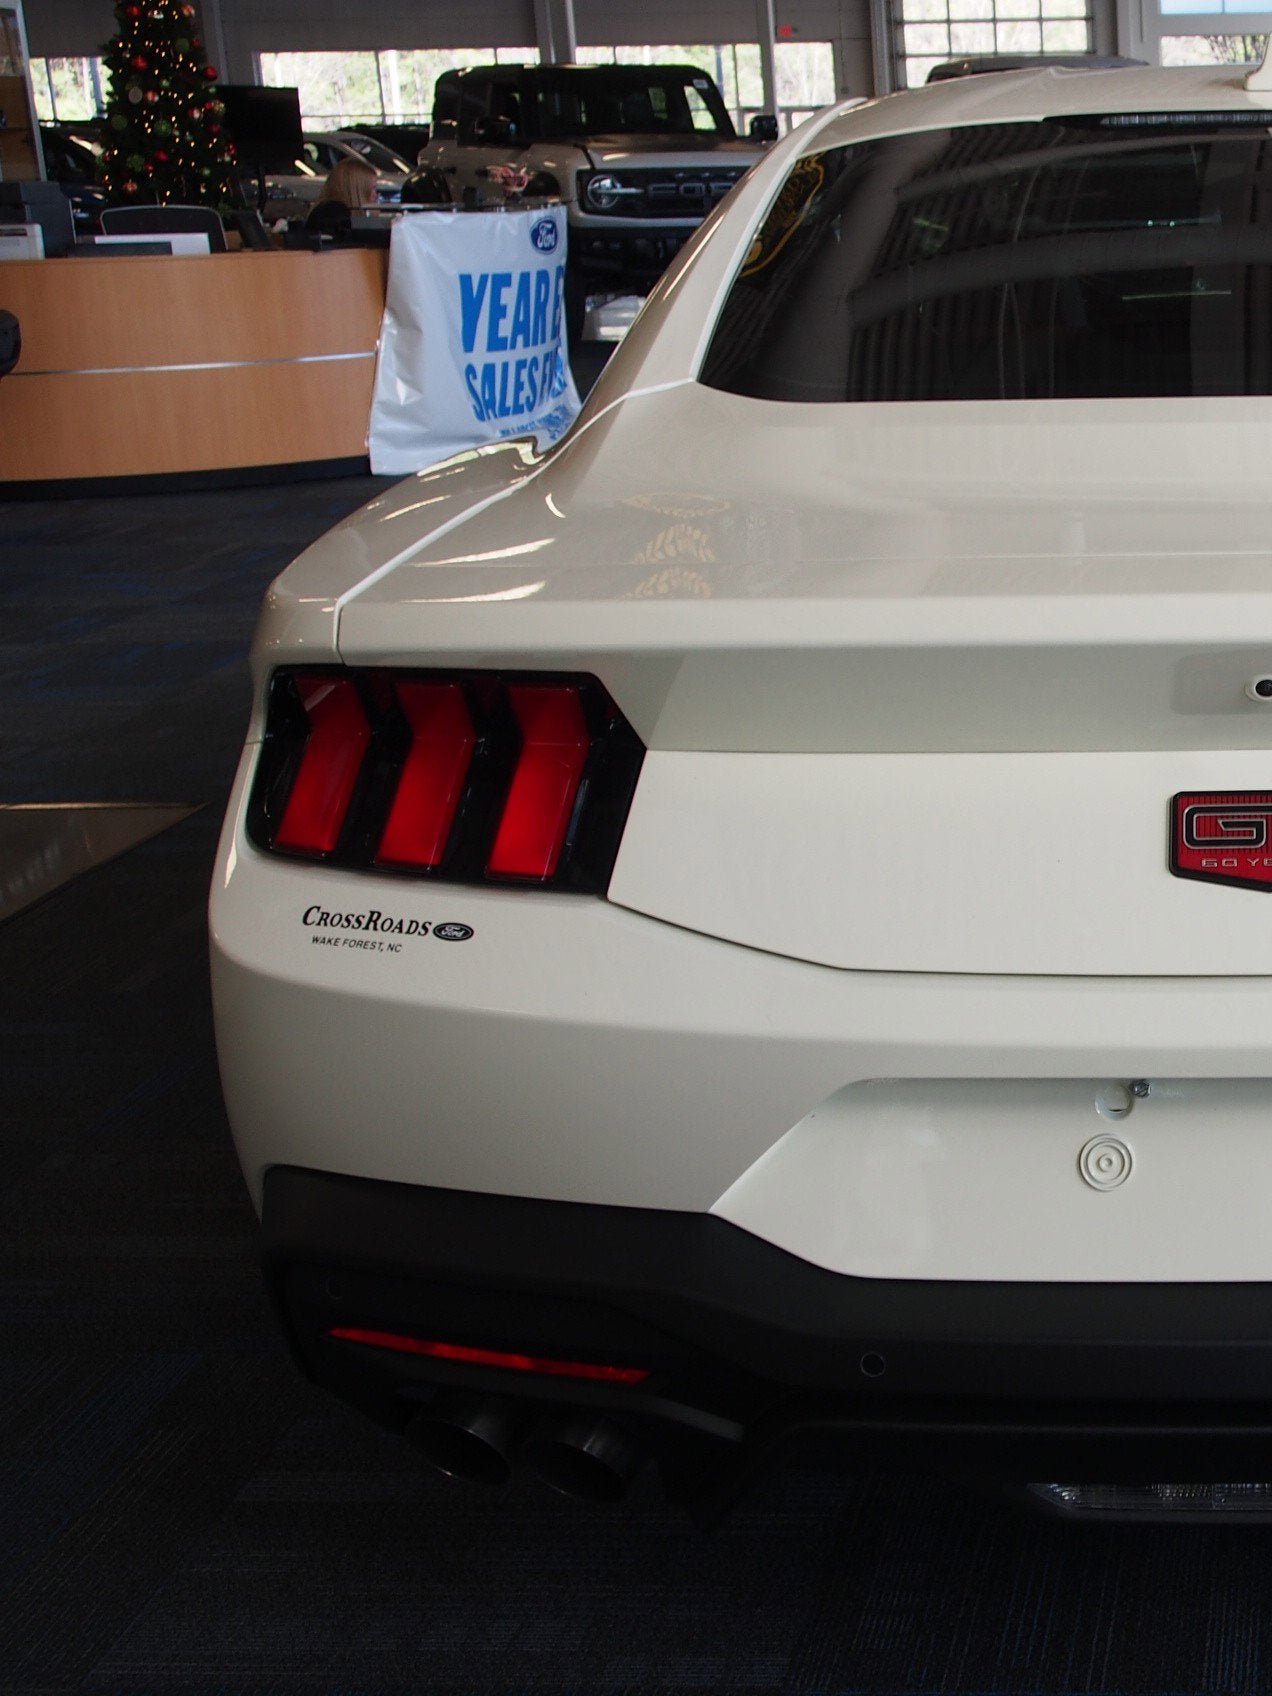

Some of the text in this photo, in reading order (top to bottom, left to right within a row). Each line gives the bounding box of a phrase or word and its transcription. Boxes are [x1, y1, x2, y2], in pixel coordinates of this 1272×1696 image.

[536, 221, 556, 249] Ford
[458, 268, 550, 353] YEAR
[465, 356, 539, 422] SALES
[1202, 858, 1237, 868] 60
[311, 935, 403, 953] WAKE FOREST, NC
